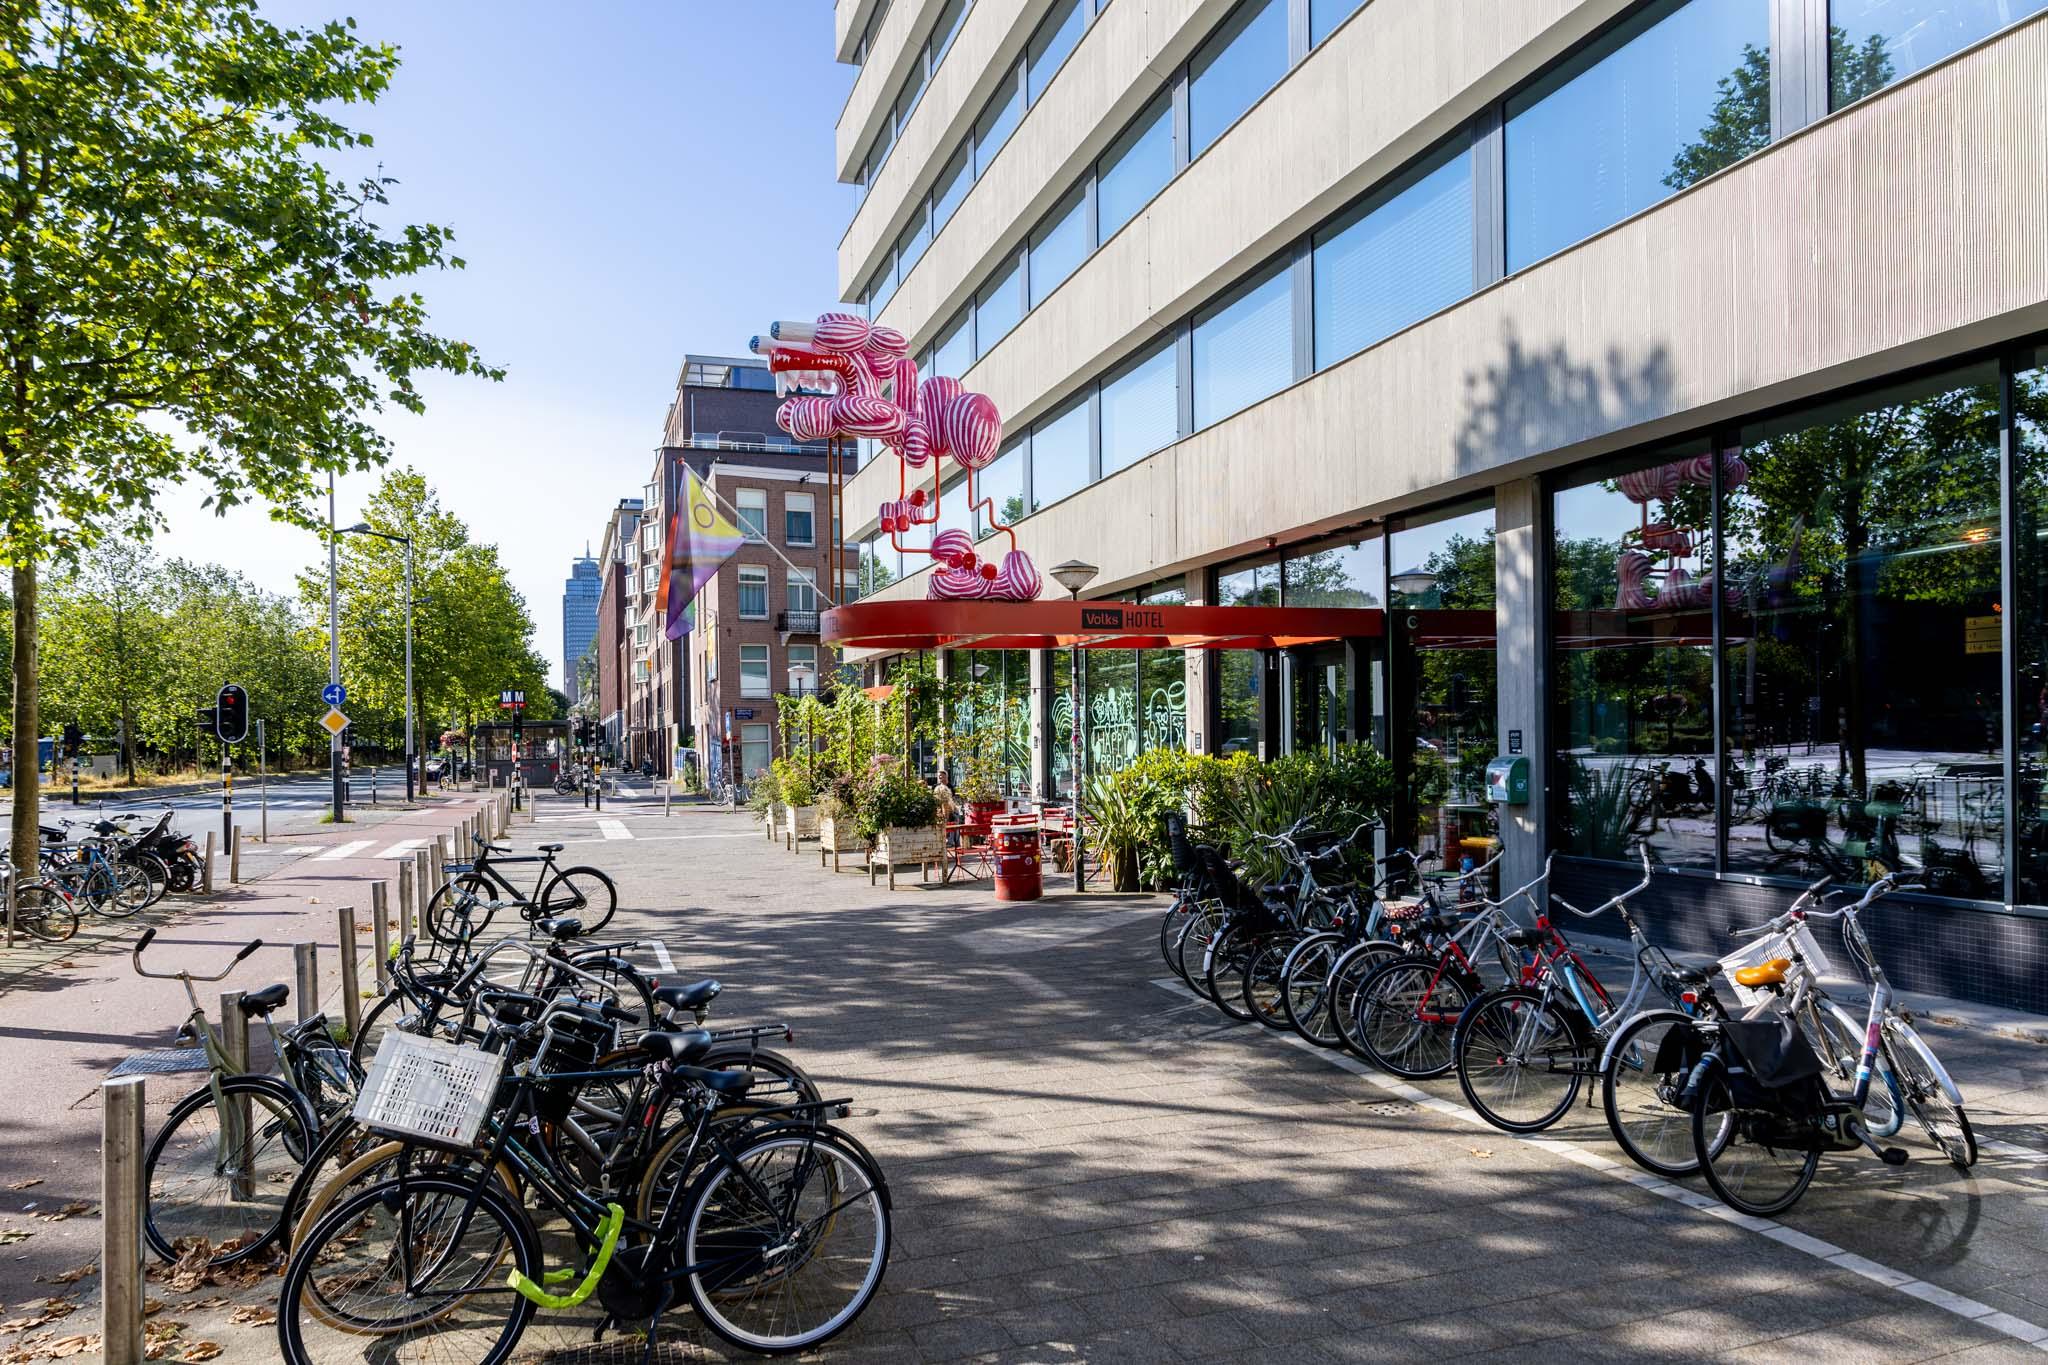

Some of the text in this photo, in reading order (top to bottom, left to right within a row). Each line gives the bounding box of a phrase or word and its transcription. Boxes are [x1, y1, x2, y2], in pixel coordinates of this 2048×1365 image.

[1086, 611, 1165, 628] Volks HOTEL
[503, 691, 512, 702] M
[515, 691, 524, 702] M
[1097, 731, 1128, 755] HAPPY
